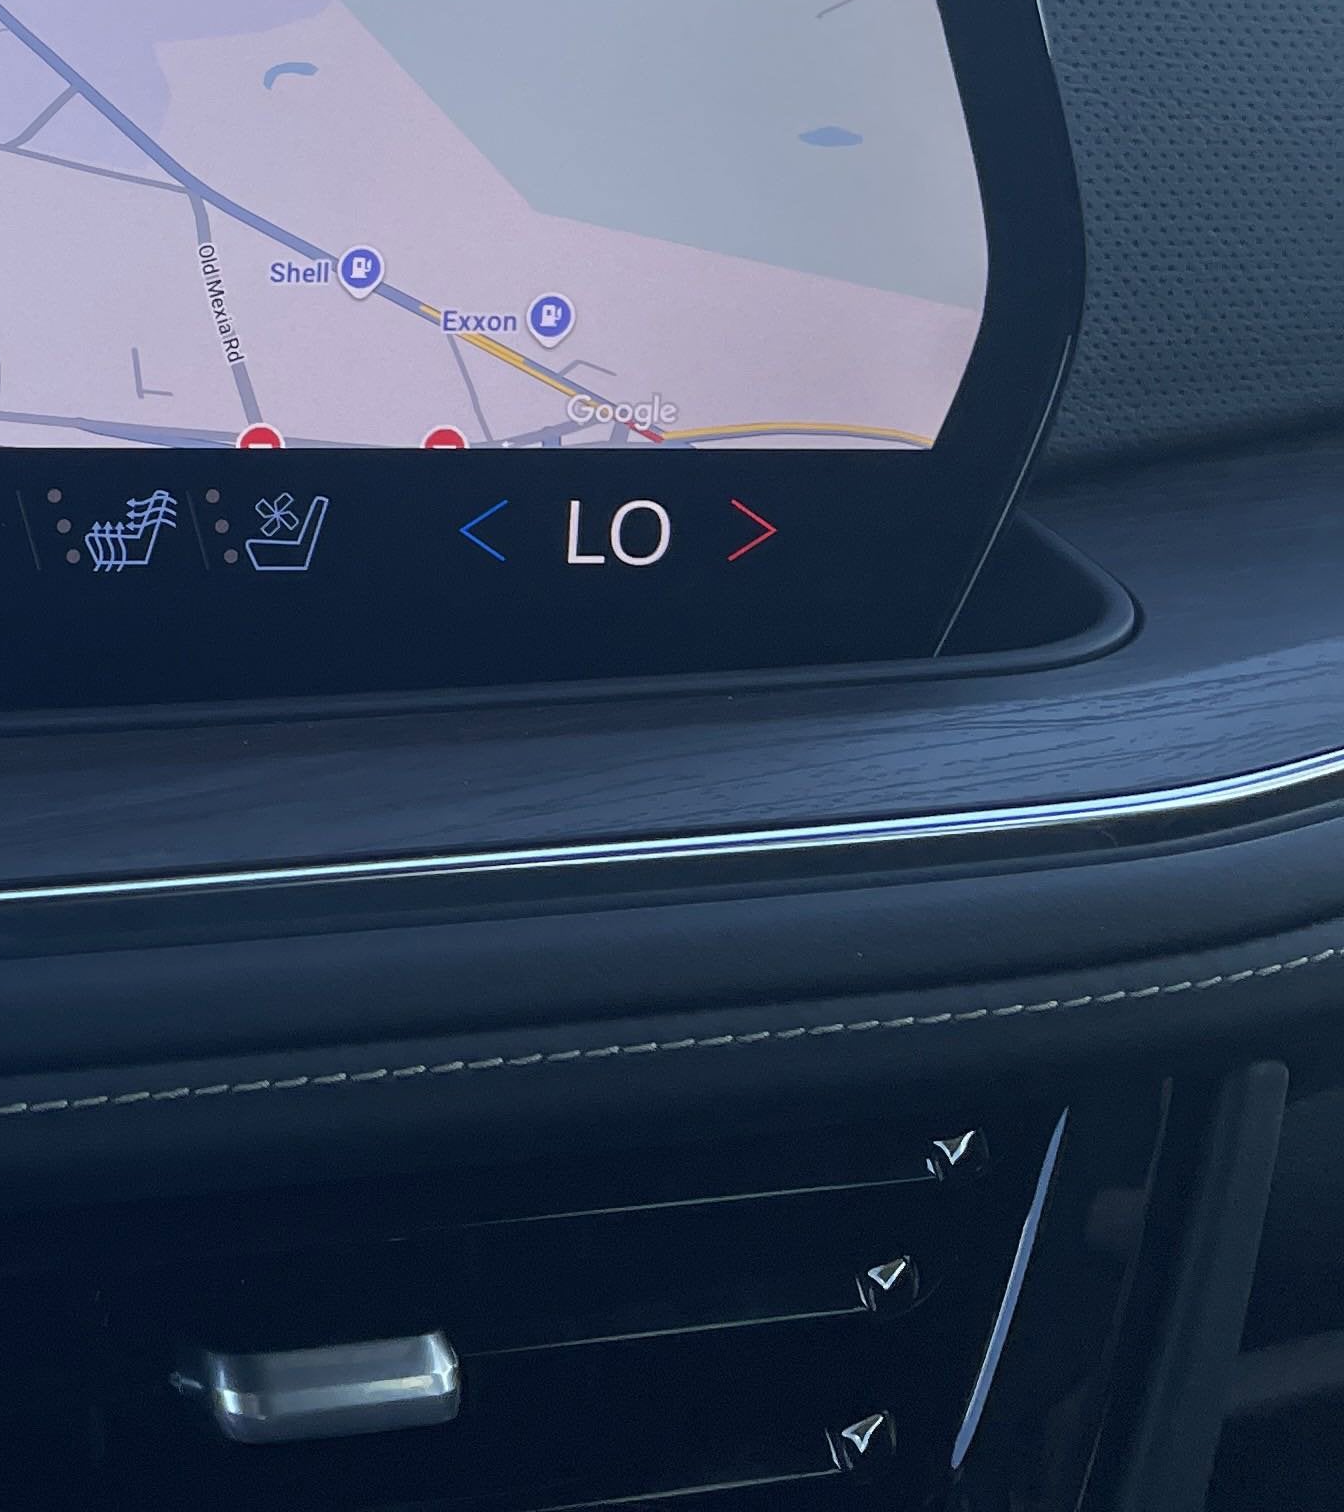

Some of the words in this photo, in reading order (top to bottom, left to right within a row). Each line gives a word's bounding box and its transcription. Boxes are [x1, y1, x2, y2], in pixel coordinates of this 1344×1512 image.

[198, 243, 217, 276] Old
[270, 261, 330, 285] Shell
[206, 278, 233, 336] Mexia
[442, 311, 518, 332] Exxon
[224, 338, 243, 364] Rd
[567, 393, 678, 430] Google
[567, 499, 671, 566] LO
